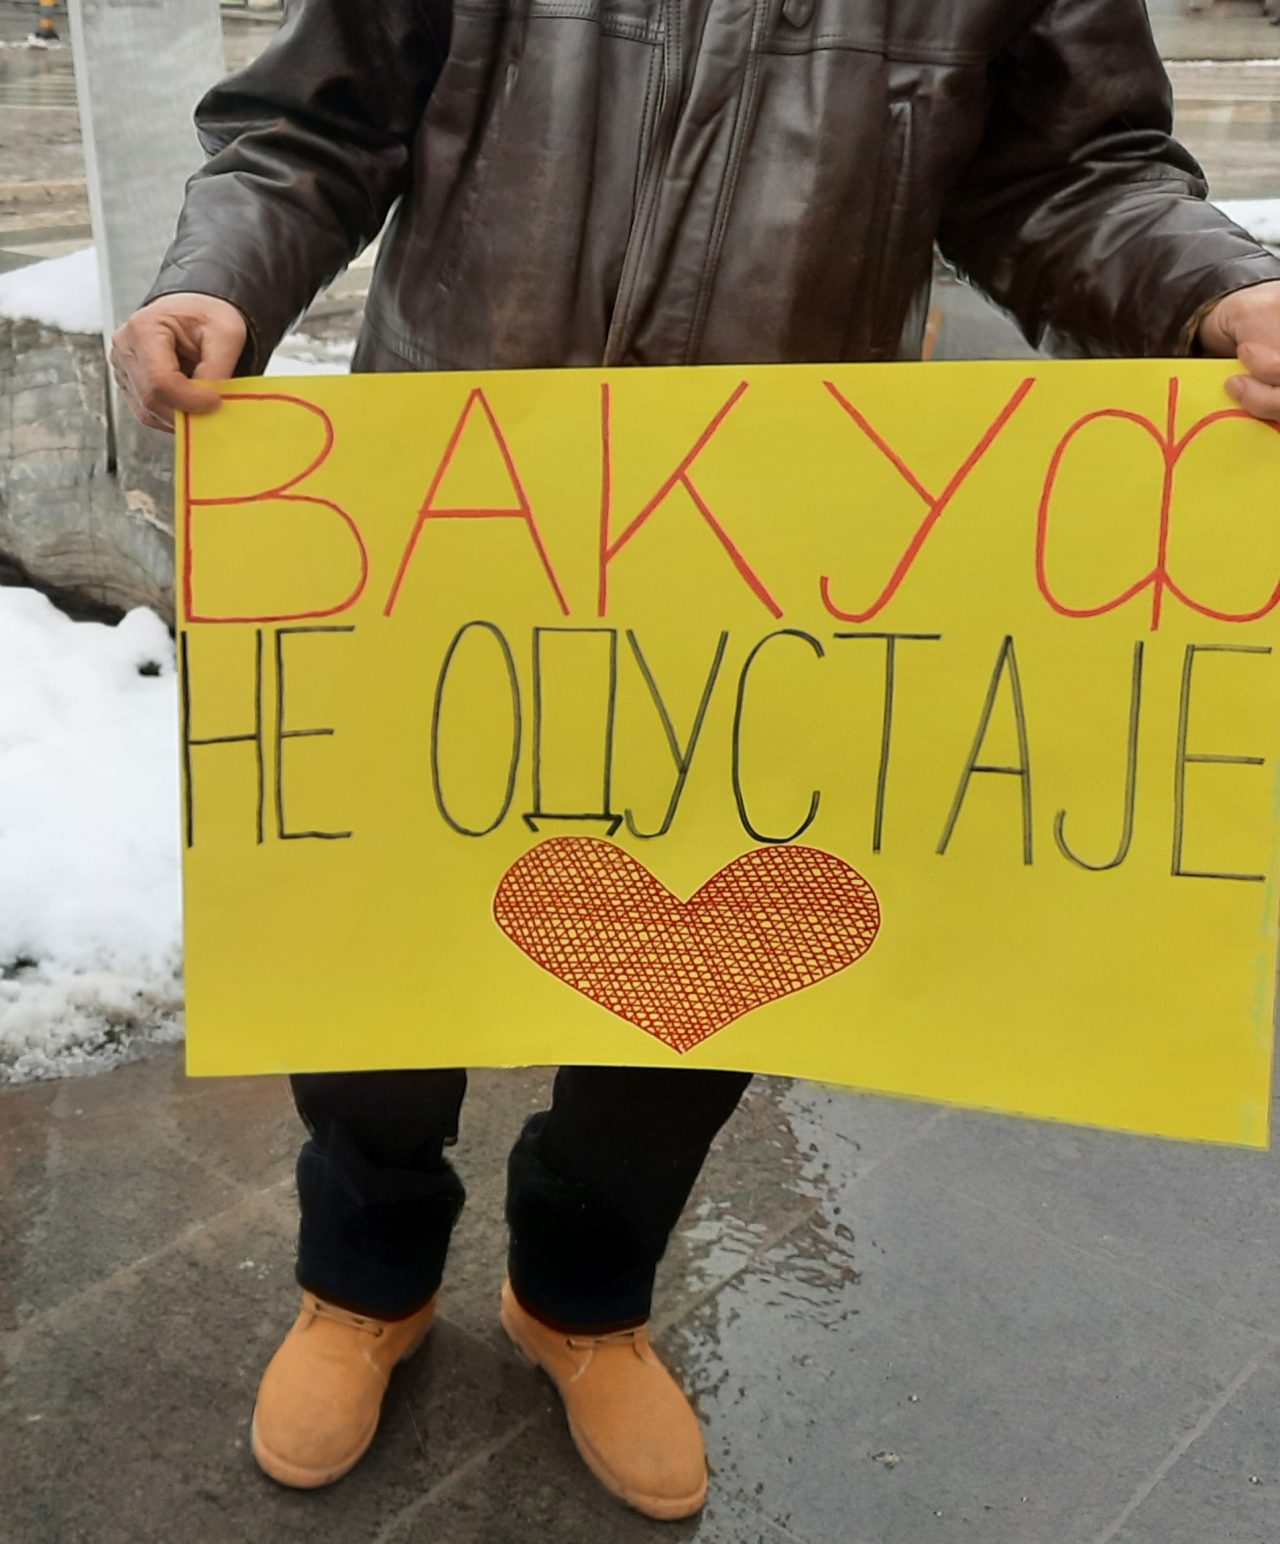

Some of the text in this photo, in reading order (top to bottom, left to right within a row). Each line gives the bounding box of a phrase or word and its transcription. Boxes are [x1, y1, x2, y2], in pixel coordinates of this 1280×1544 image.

[183, 375, 1280, 624] ВАКУФ
[181, 620, 1273, 884] НЕ ОДУСТАЈЕ
